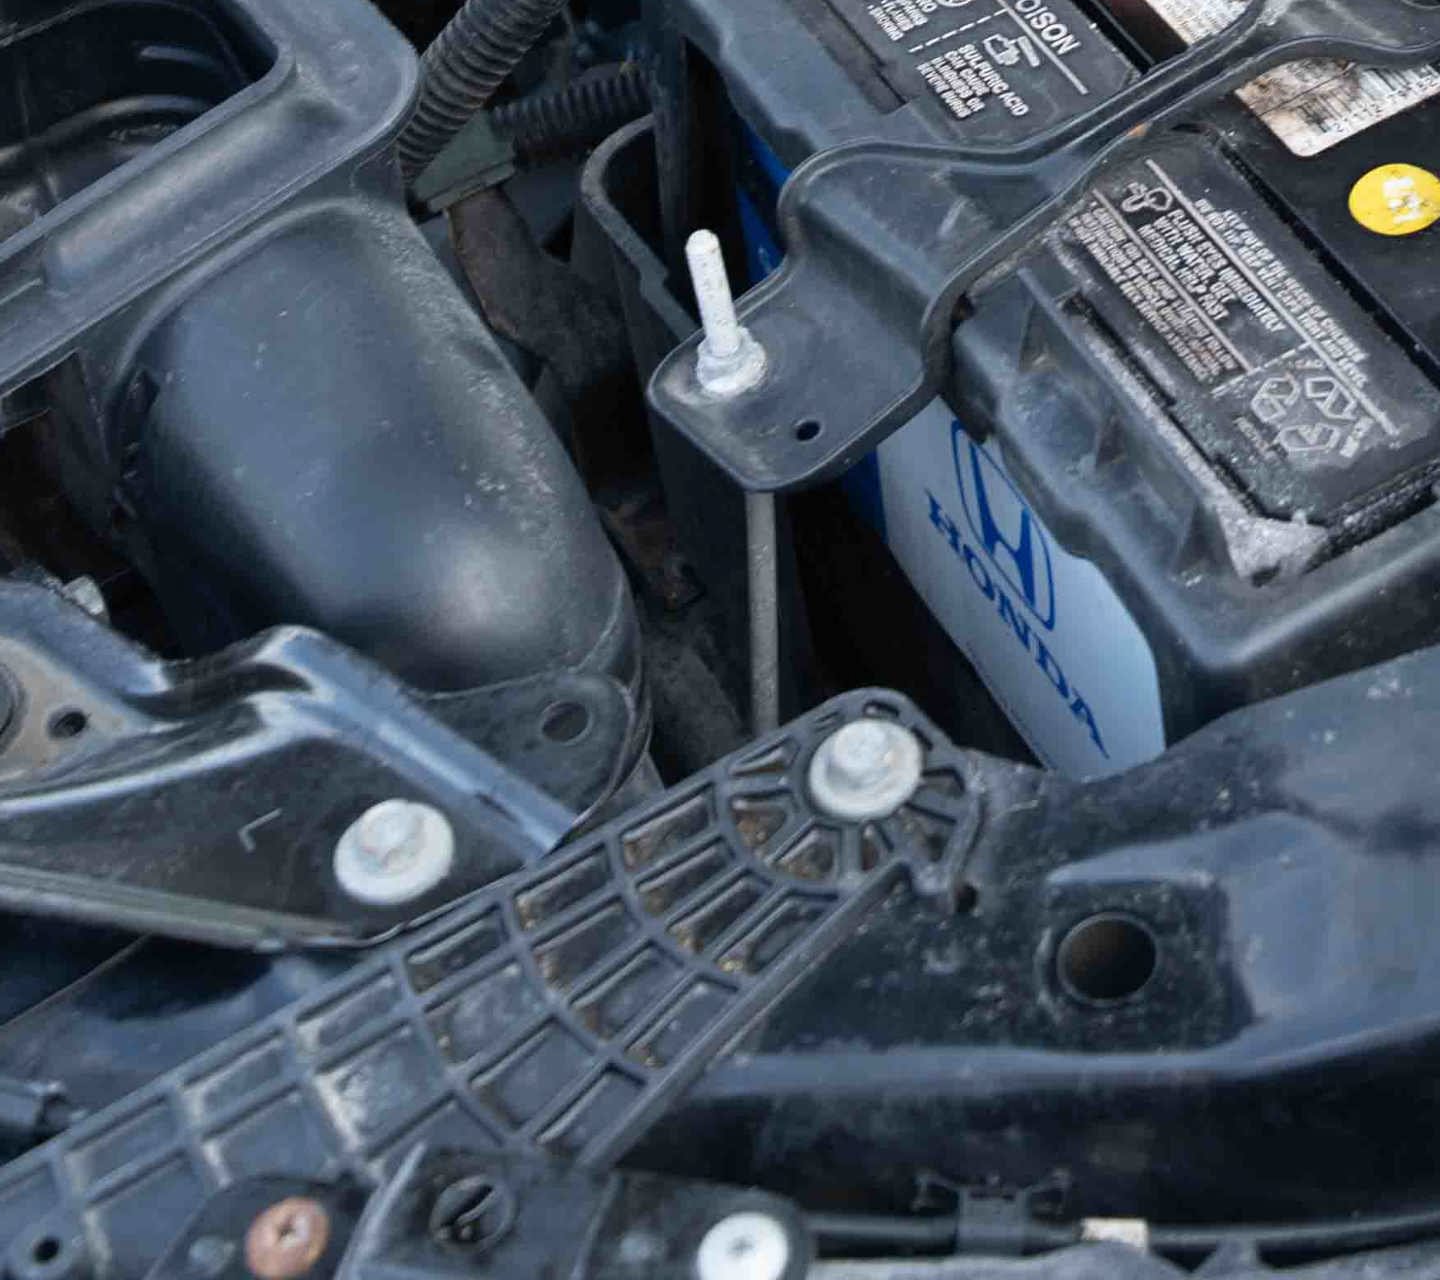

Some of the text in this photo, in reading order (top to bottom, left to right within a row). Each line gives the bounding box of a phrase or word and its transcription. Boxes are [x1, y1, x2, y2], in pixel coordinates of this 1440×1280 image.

[955, 43, 1031, 117] SULFURIC ACID
[1135, 223, 1230, 321] MEDICAL HELP FAST
[1150, 215, 1186, 244] WITH
[1208, 280, 1236, 303] GET
[1165, 207, 1287, 335] FLUSH EYES IMMEDIATELY
[926, 490, 1110, 760] HONDA
